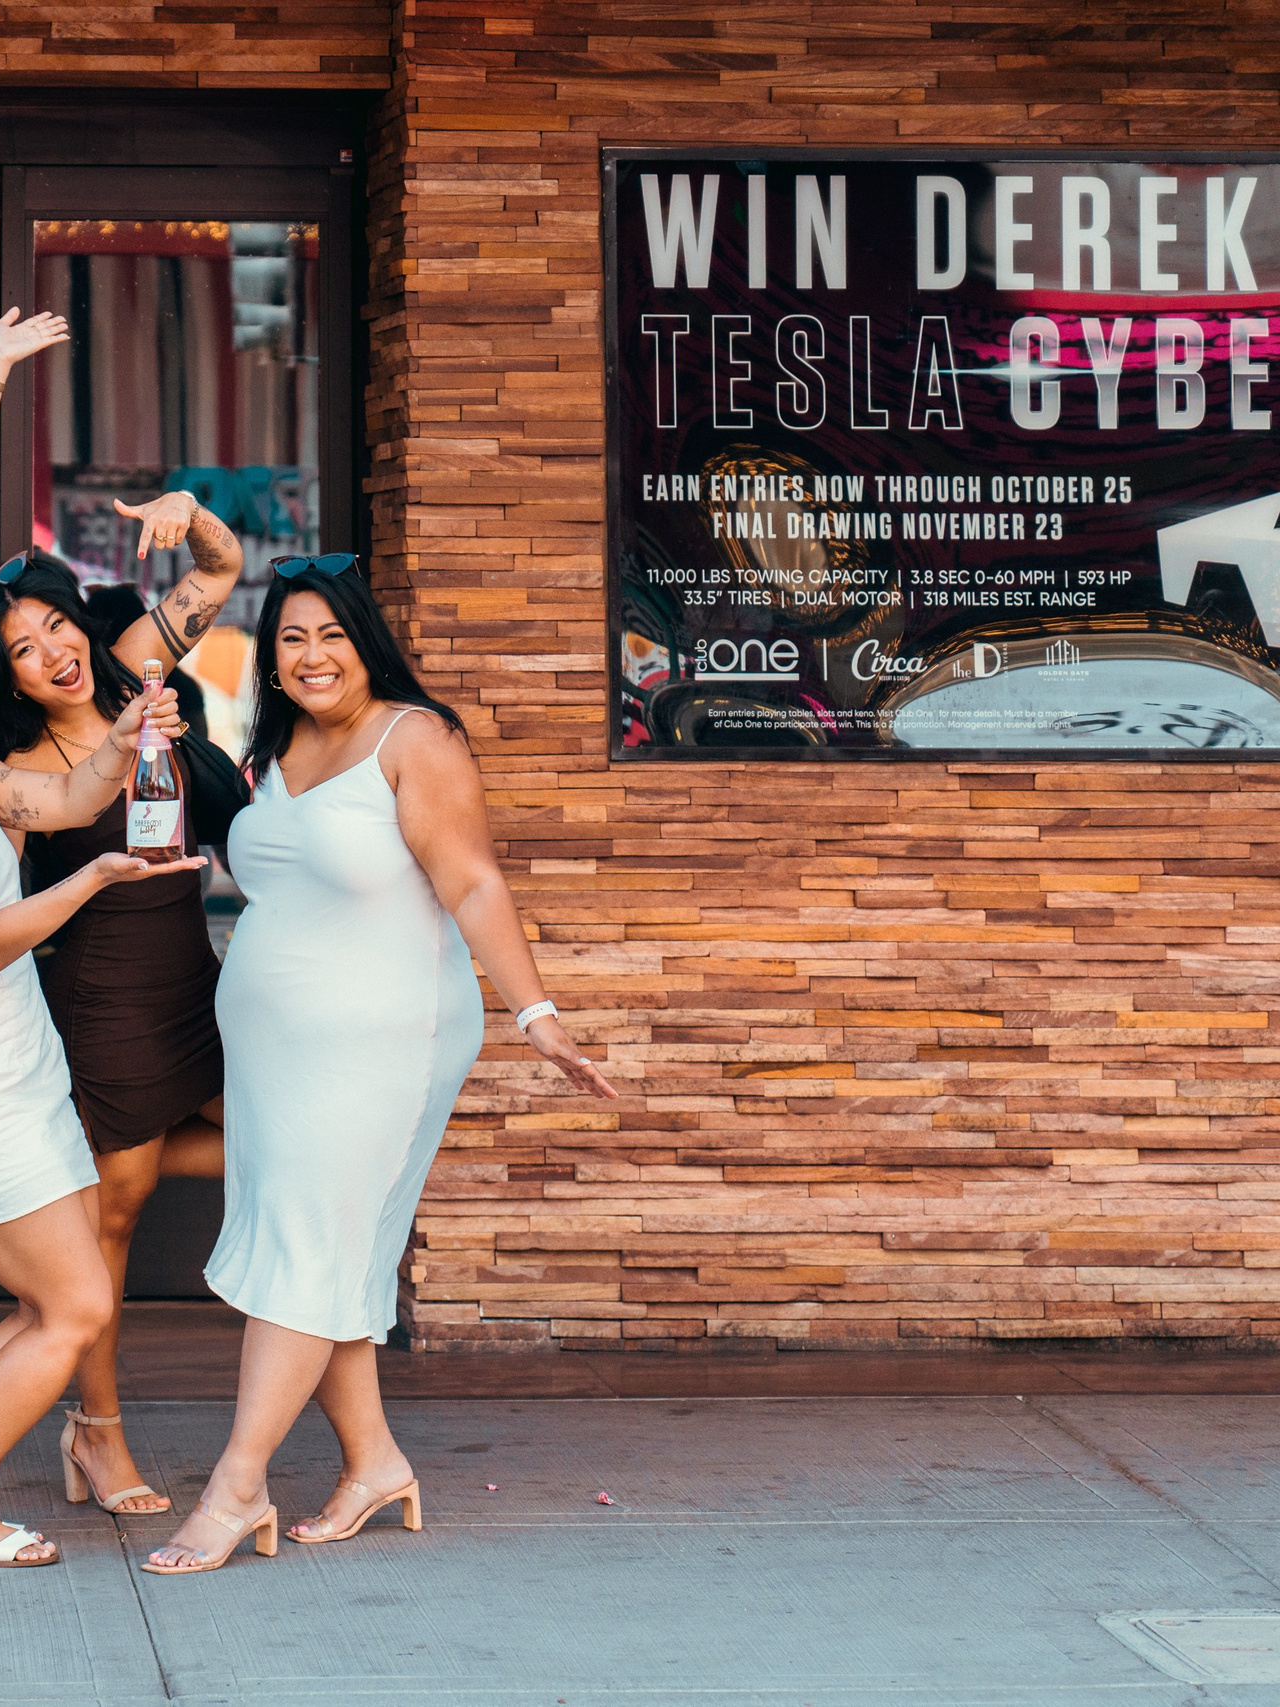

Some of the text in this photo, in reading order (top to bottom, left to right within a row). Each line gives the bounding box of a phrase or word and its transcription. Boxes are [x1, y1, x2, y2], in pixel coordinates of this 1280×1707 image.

[639, 173, 1259, 292] WIN DEREK
[640, 313, 1273, 431] TESLA CYBE
[643, 474, 1133, 504] EARN ENTRIES NOW THROUGH OCTOBER 25
[713, 512, 1063, 541] FINAL DRAWING NOVEMBER 23
[646, 568, 697, 586] 11,000
[701, 569, 731, 584] LBS
[735, 569, 804, 584] TOWING
[808, 569, 889, 584] CAPACITY
[910, 570, 934, 585] 3.8
[938, 570, 970, 585] SEC
[1020, 570, 1055, 585] MPH
[1077, 570, 1106, 586] 593
[1110, 571, 1132, 585] HP
[727, 590, 772, 605] TIRES
[794, 591, 838, 605] DUAL
[841, 591, 902, 606] MOTOR
[923, 592, 948, 606] 318
[953, 592, 999, 606] MILES
[1003, 592, 1035, 606] EST.
[1040, 592, 1096, 607] RANGE
[694, 638, 708, 672] club
[708, 638, 800, 672] one
[851, 638, 929, 682] Circa
[952, 659, 972, 678] the
[973, 642, 1002, 678] D
[708, 709, 727, 717] Earn
[728, 709, 755, 717] entries
[757, 709, 787, 719] playing
[788, 709, 816, 718] tables,
[817, 709, 836, 717] slots
[837, 709, 854, 717] and
[854, 709, 876, 717] keno.
[877, 709, 894, 717] Visit
[895, 709, 915, 717] Club
[939, 709, 949, 717] for
[951, 710, 972, 718] more
[973, 709, 1002, 718] details.
[1004, 710, 1023, 718] Must
[1025, 710, 1036, 718] be
[1045, 710, 1079, 718] member
[714, 720, 723, 728] of
[724, 720, 743, 728] Club
[745, 720, 763, 728] One
[764, 720, 773, 728] to
[774, 720, 819, 729] participate
[821, 720, 837, 728] and
[838, 720, 855, 728] win.
[856, 720, 872, 728] This
[873, 720, 880, 728] is
[903, 721, 947, 730] promotion.
[948, 720, 1002, 730] Management
[1004, 721, 1036, 729] reserves
[1037, 720, 1048, 729] all
